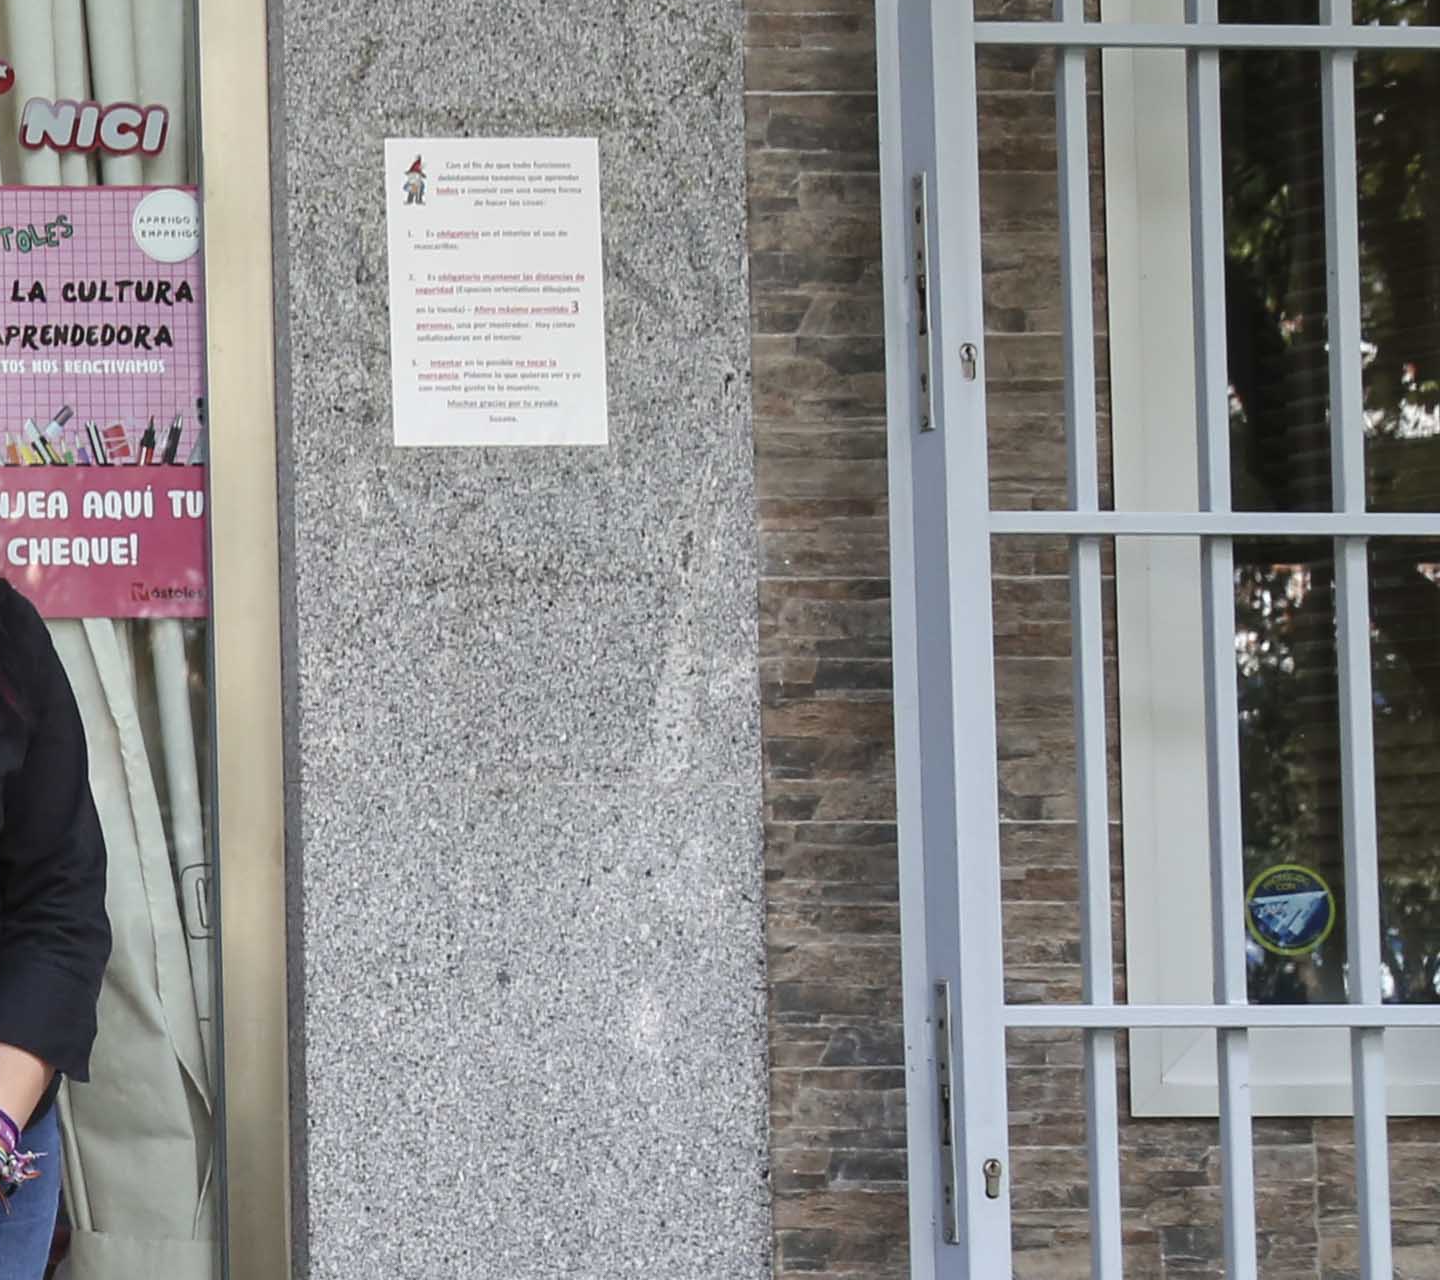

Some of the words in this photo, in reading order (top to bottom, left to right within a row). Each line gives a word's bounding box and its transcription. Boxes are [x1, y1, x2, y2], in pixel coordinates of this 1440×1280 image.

[19, 96, 170, 156] NICI
[11, 279, 47, 304] LA
[61, 278, 194, 305] CULTURA
[571, 300, 580, 314] 3
[32, 358, 59, 374] NOS
[63, 357, 166, 375] REACTIVAMOS
[82, 486, 155, 519] AQUÍ
[168, 490, 204, 518] TU
[7, 536, 139, 566] CHEQUE!
